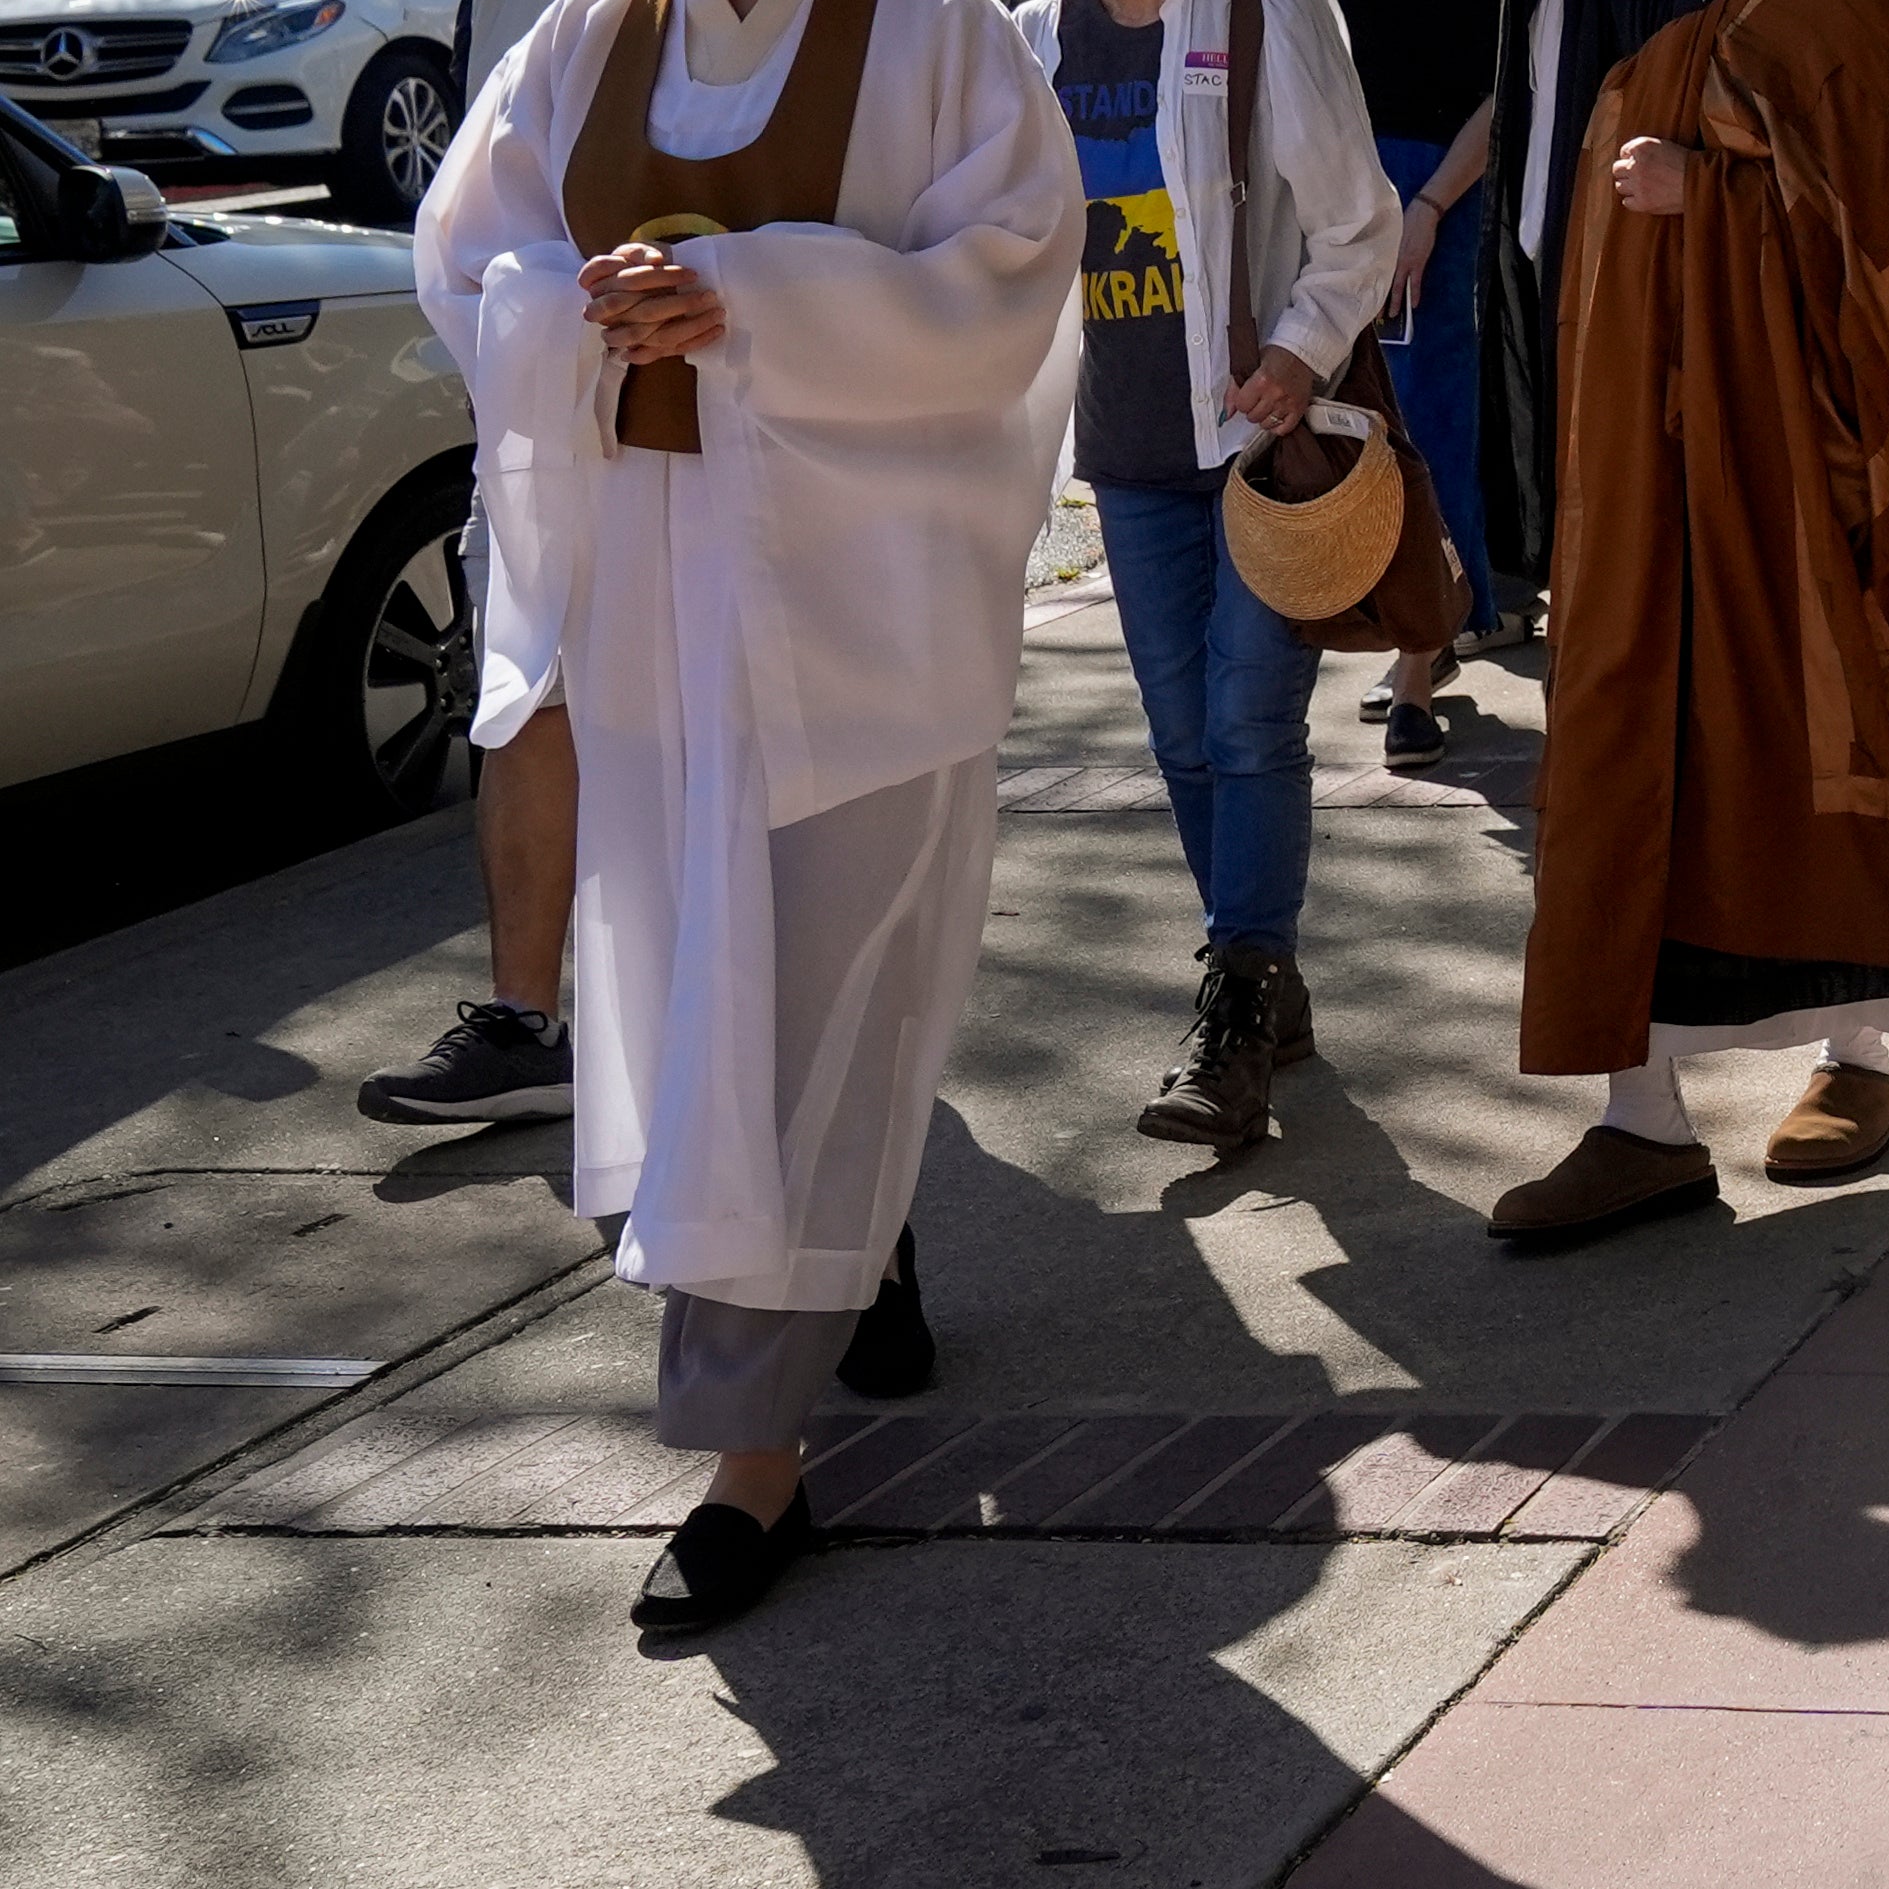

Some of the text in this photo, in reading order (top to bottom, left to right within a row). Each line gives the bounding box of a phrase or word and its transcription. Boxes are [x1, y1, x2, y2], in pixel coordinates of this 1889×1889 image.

[1058, 79, 1156, 120] STAND
[1184, 72, 1223, 87] STAC
[1081, 262, 1184, 321] KRAI
